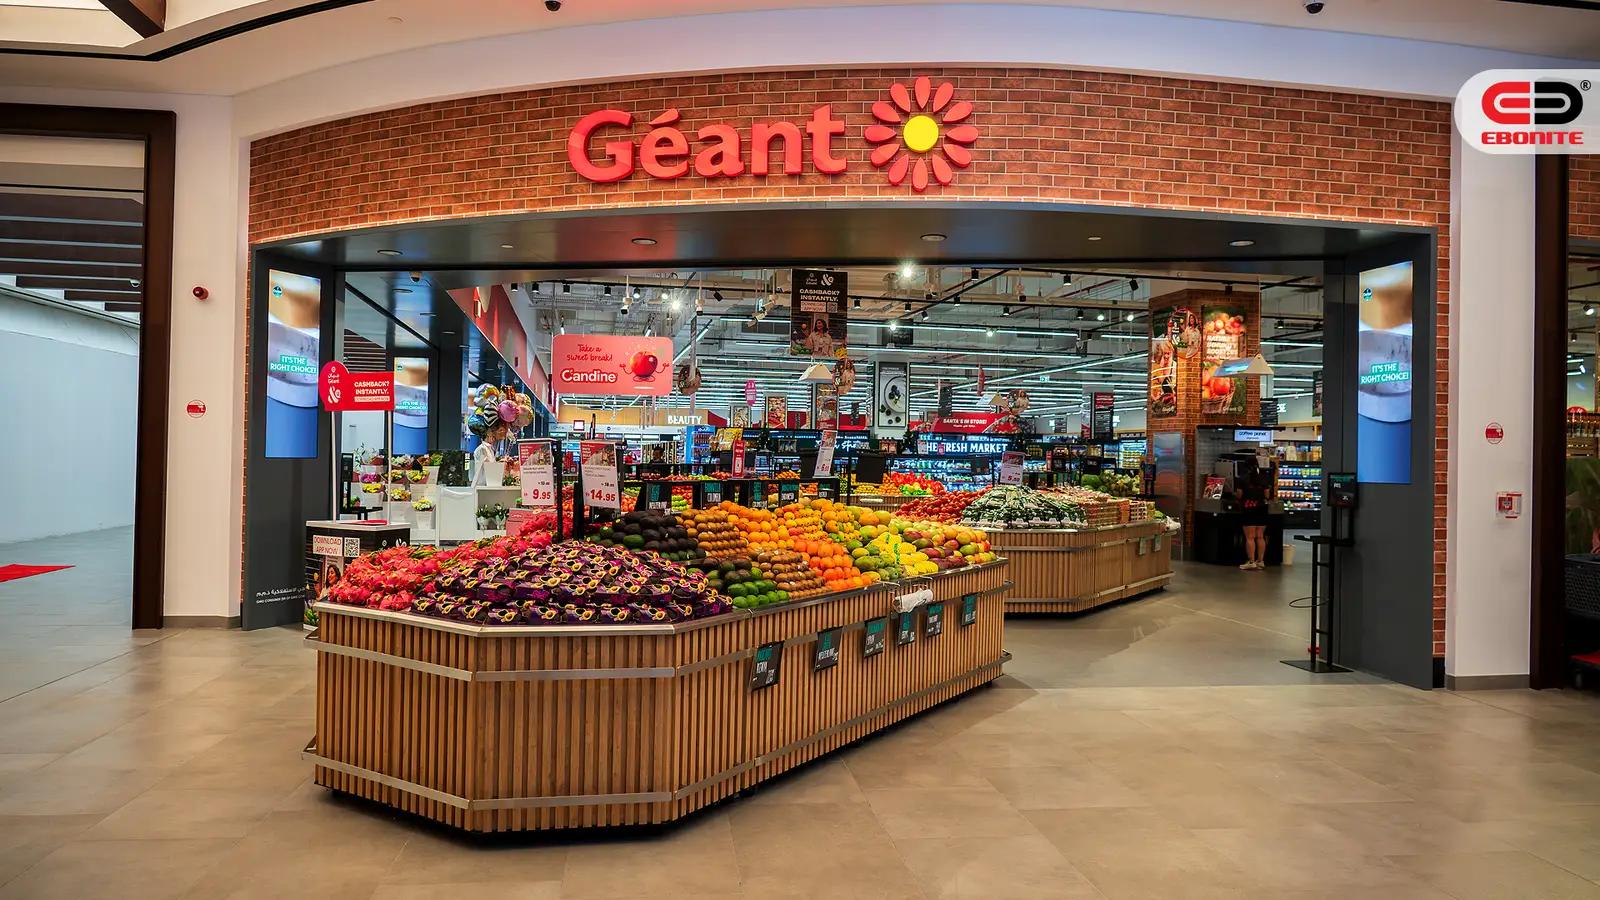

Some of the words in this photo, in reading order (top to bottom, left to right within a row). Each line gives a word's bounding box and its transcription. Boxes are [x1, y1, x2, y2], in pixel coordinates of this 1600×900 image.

[567, 104, 848, 183] Géant
[577, 343, 595, 353] Take
[281, 355, 294, 364] IT'S
[293, 356, 306, 365] THE
[566, 353, 589, 362] sweet
[589, 353, 613, 362] break!
[270, 362, 290, 372] RIGHT
[290, 364, 317, 374] CHOICE!
[1372, 364, 1384, 373] IT'S
[1384, 363, 1397, 372] THE
[561, 369, 617, 383] Candine
[1360, 374, 1381, 384] RIGHT
[1381, 371, 1409, 382] CHOICE!
[668, 415, 702, 425] BEAUTY
[927, 442, 938, 452] HE
[970, 444, 1008, 452] MARKET
[532, 488, 551, 500] 9.95
[590, 488, 616, 502] 14.95
[314, 536, 342, 546] DOWNLOAD
[316, 546, 325, 554] APP
[325, 547, 339, 555] NOW
